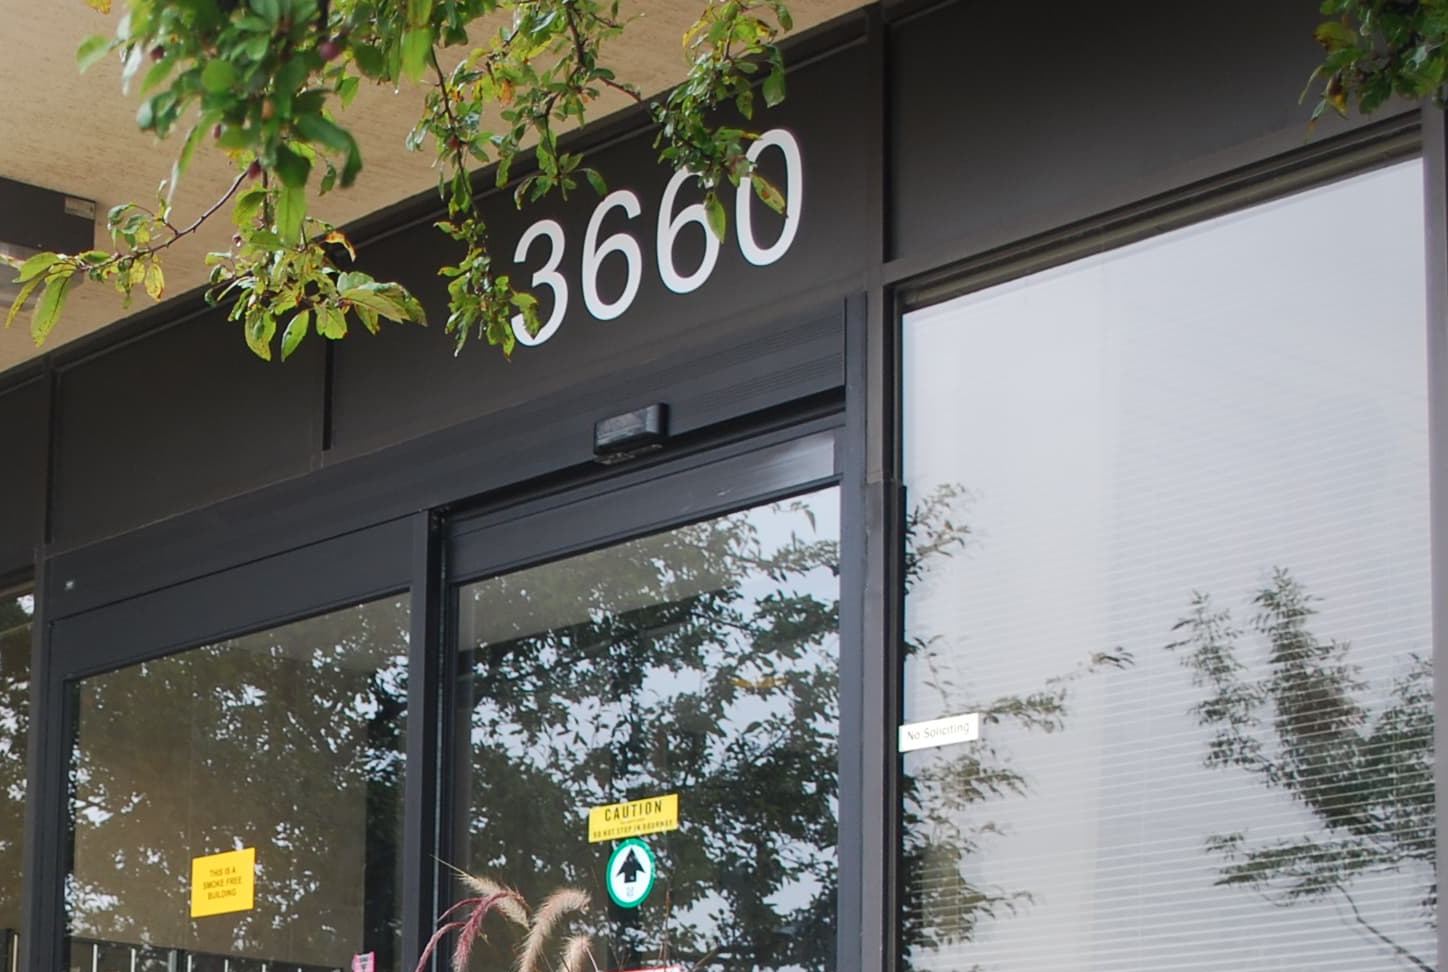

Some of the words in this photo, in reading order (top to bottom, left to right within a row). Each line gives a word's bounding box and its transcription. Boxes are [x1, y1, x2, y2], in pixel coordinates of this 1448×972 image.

[510, 128, 803, 347] 3660
[907, 731, 921, 741] No
[923, 722, 970, 738] Soliciting
[605, 800, 662, 822] CAUTION
